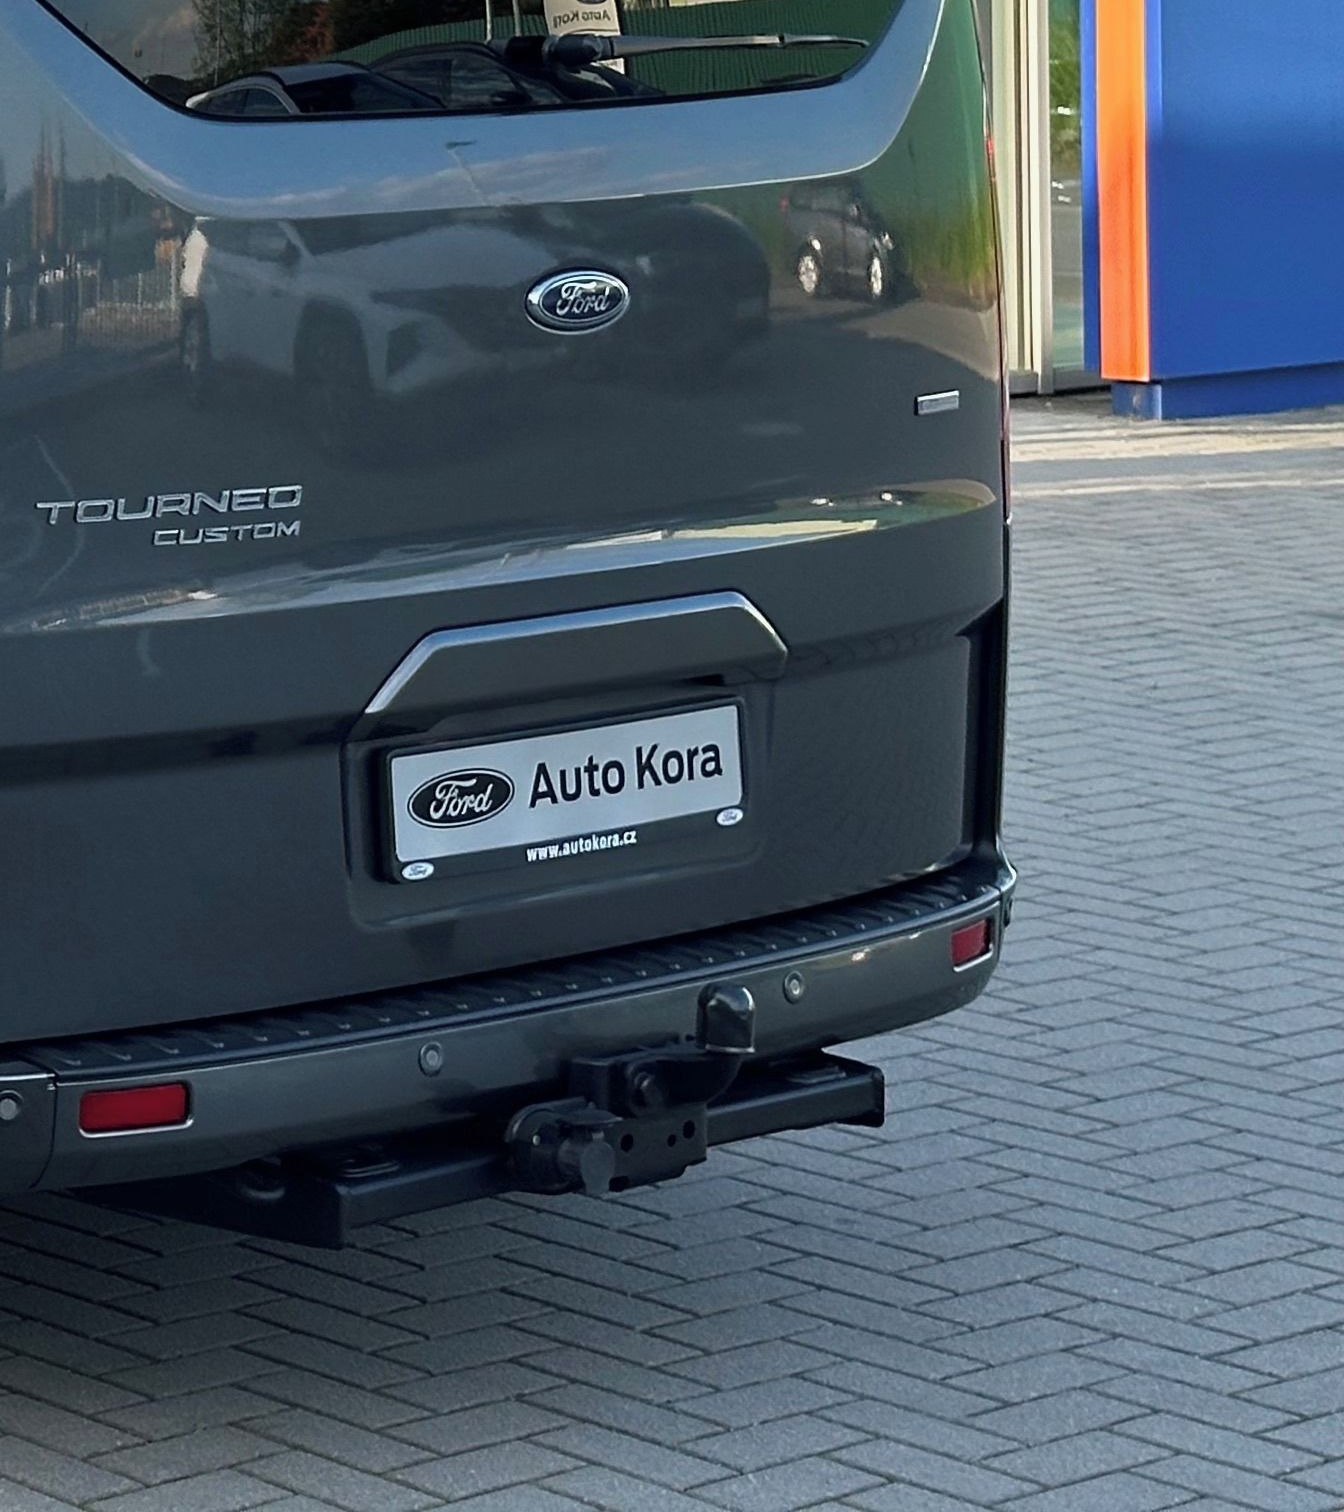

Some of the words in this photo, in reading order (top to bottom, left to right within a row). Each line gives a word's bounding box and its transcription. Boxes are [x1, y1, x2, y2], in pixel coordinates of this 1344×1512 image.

[556, 281, 610, 316] Ford
[36, 485, 303, 525] TOURNEO
[153, 520, 302, 546] CUSTOM
[429, 778, 494, 820] Ford
[529, 755, 626, 809] Auto
[635, 743, 723, 790] Kora
[526, 830, 637, 862] www.autokora.cz
